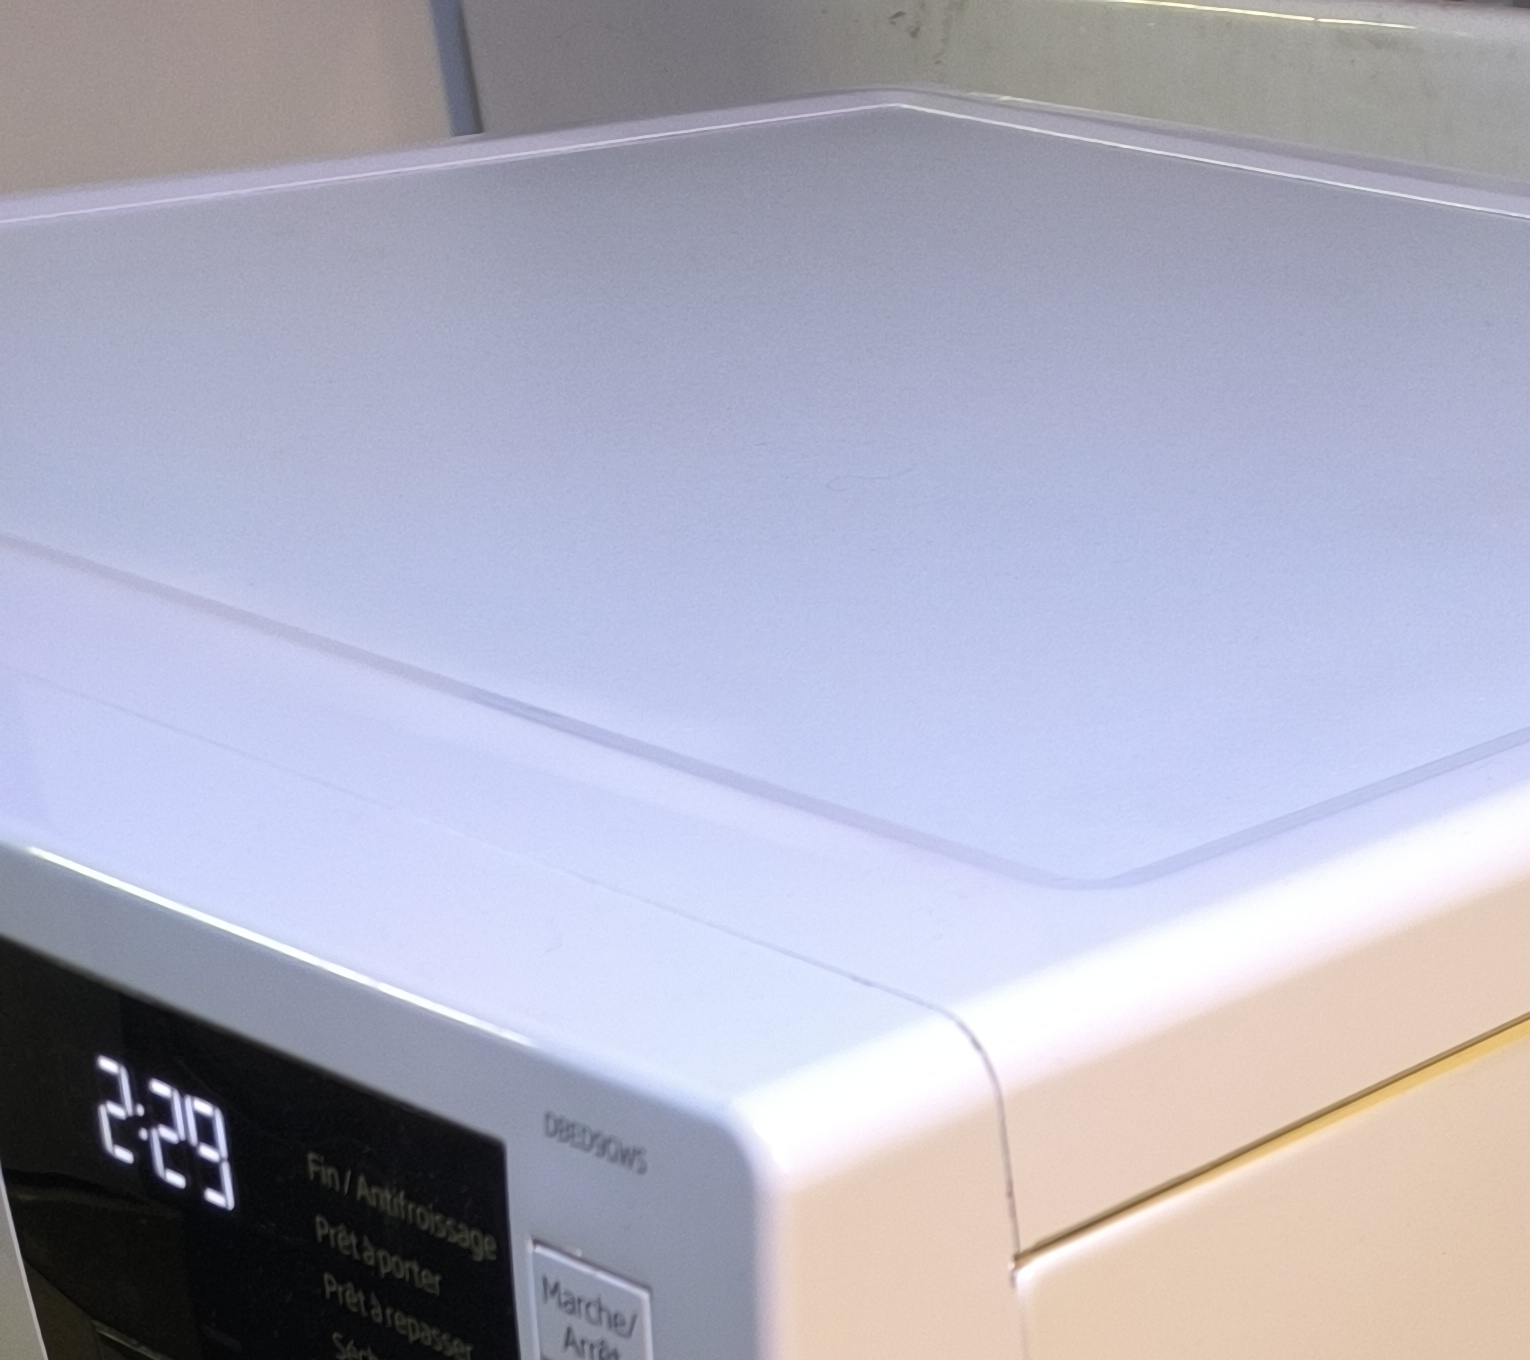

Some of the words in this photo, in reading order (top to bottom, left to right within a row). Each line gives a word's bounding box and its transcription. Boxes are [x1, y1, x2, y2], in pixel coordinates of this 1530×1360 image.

[97, 1055, 237, 1211] 2:29
[307, 1151, 340, 1193] Fin
[357, 1172, 498, 1262] Antifroissage
[315, 1213, 361, 1261] Prêt
[377, 1248, 442, 1296] porter
[323, 1271, 368, 1318] Prêt
[542, 1272, 639, 1340] Marche/
